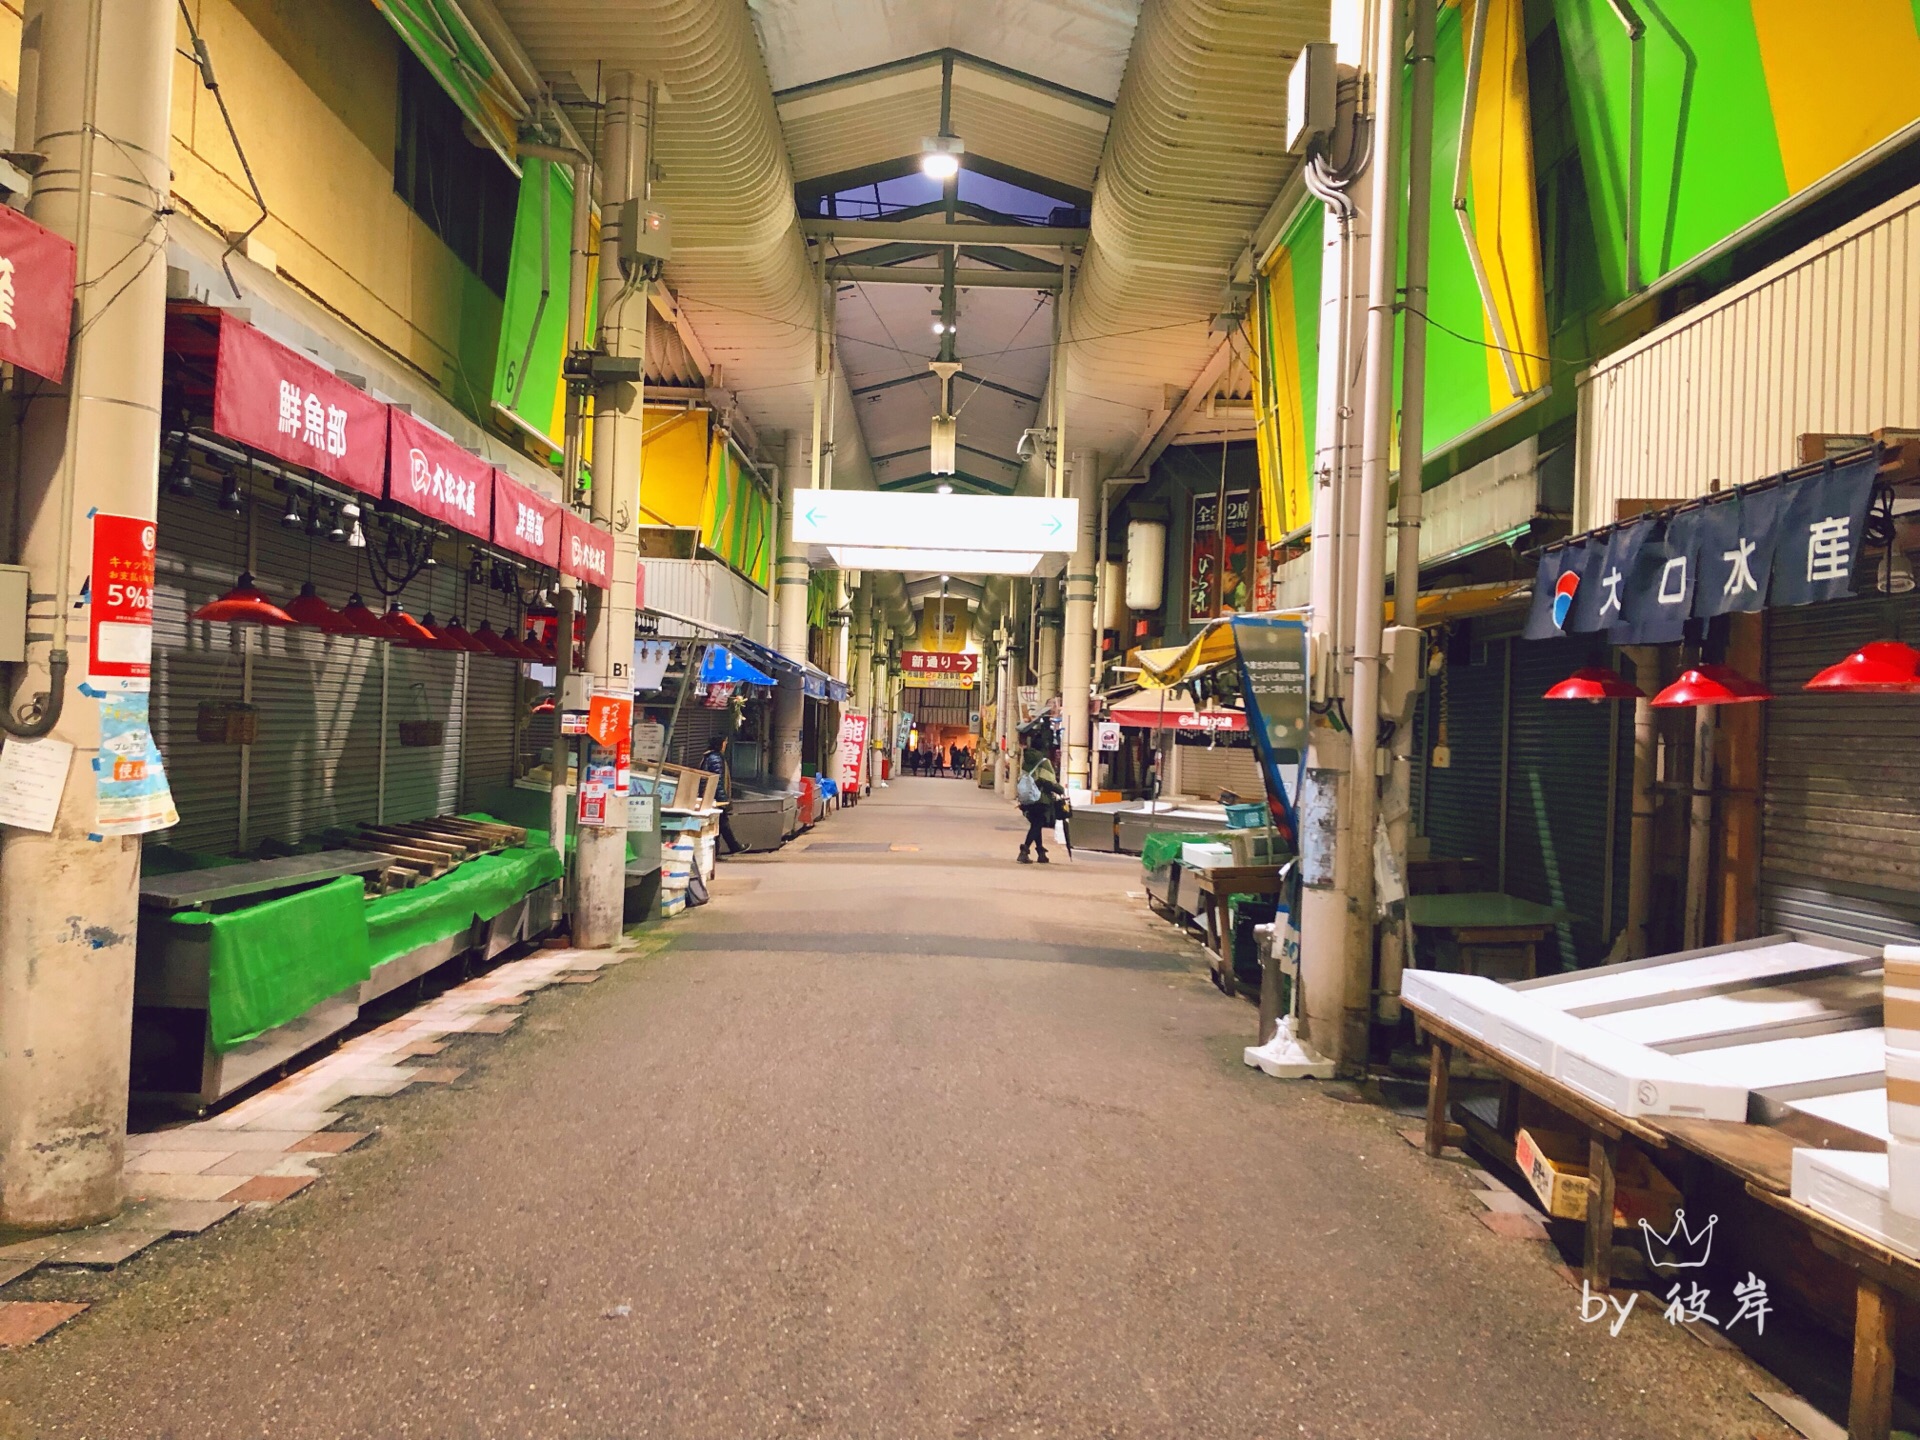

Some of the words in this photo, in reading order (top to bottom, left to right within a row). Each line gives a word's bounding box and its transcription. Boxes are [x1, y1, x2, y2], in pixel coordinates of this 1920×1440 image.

[506, 360, 516, 394] 6
[278, 379, 348, 459] 鮮魚部
[432, 462, 477, 518] 大松水産
[515, 501, 545, 547] 鮮魚部
[582, 542, 606, 577] 大松水産
[1599, 515, 1851, 616] 大口水産
[613, 662, 628, 677] B1
[911, 654, 951, 669] 新通り
[609, 702, 621, 732] ペイペイ
